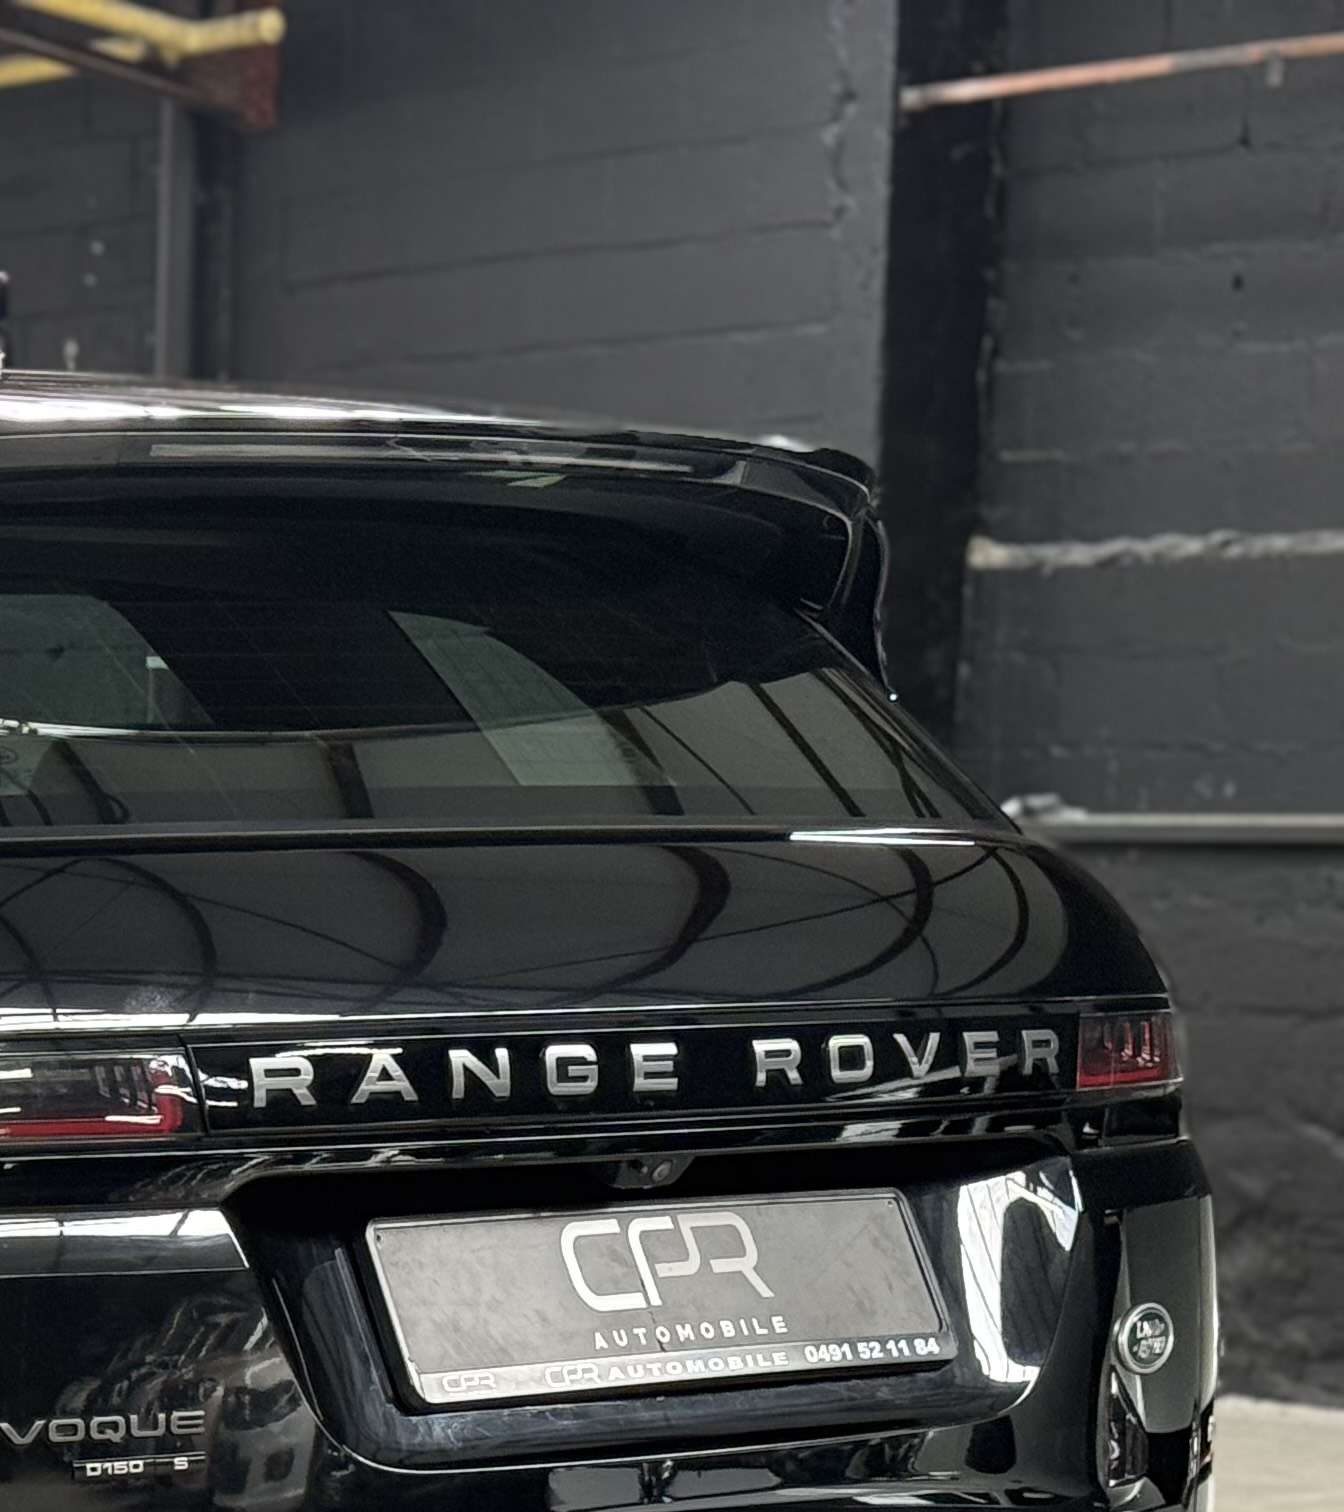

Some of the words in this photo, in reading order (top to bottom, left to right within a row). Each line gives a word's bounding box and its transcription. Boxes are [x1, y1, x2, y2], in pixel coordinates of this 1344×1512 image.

[248, 1042, 679, 1109] RANGE
[751, 1028, 1061, 1087] ROVER
[560, 1211, 775, 1312] CPR
[593, 1315, 789, 1350] AUTOMOBILE
[441, 1371, 496, 1393] CPR
[544, 1362, 603, 1389] CPR
[607, 1350, 790, 1381] AUTOMOBILE
[804, 1342, 853, 1364] 0491
[857, 1340, 884, 1360] 52
[886, 1338, 910, 1358] 11
[85, 1459, 145, 1477] D150
[173, 1456, 189, 1471] S
